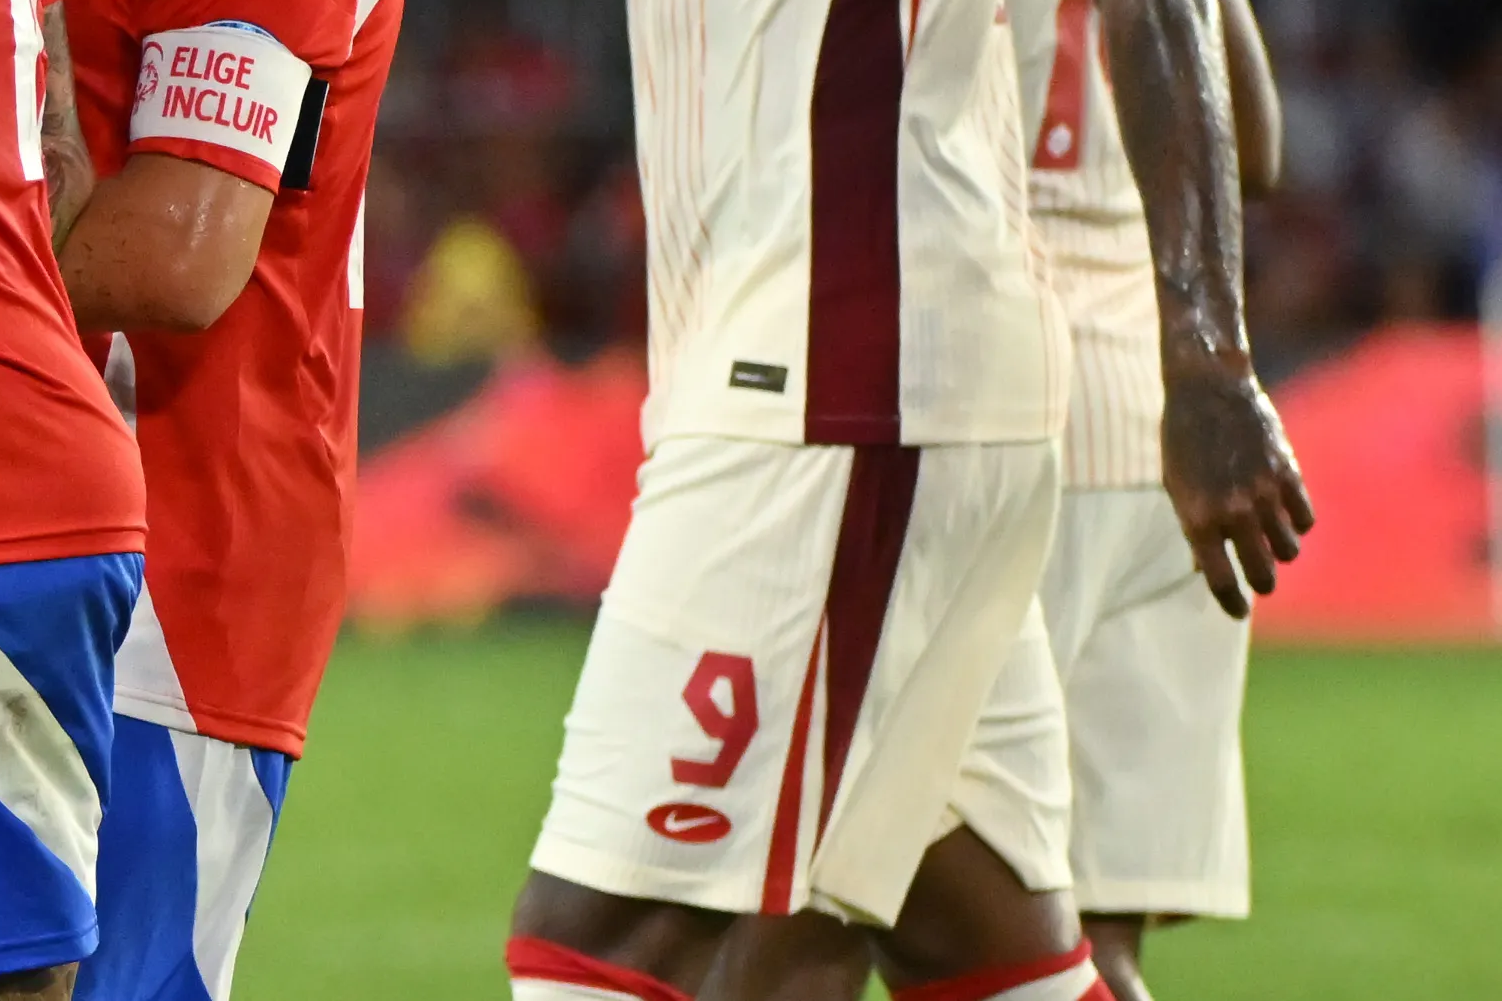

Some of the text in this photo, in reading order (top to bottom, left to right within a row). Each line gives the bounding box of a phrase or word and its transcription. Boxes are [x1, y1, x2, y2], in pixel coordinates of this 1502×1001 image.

[170, 46, 255, 91] ELIGE
[161, 85, 279, 145] INCLUIR
[670, 649, 760, 789] 9
